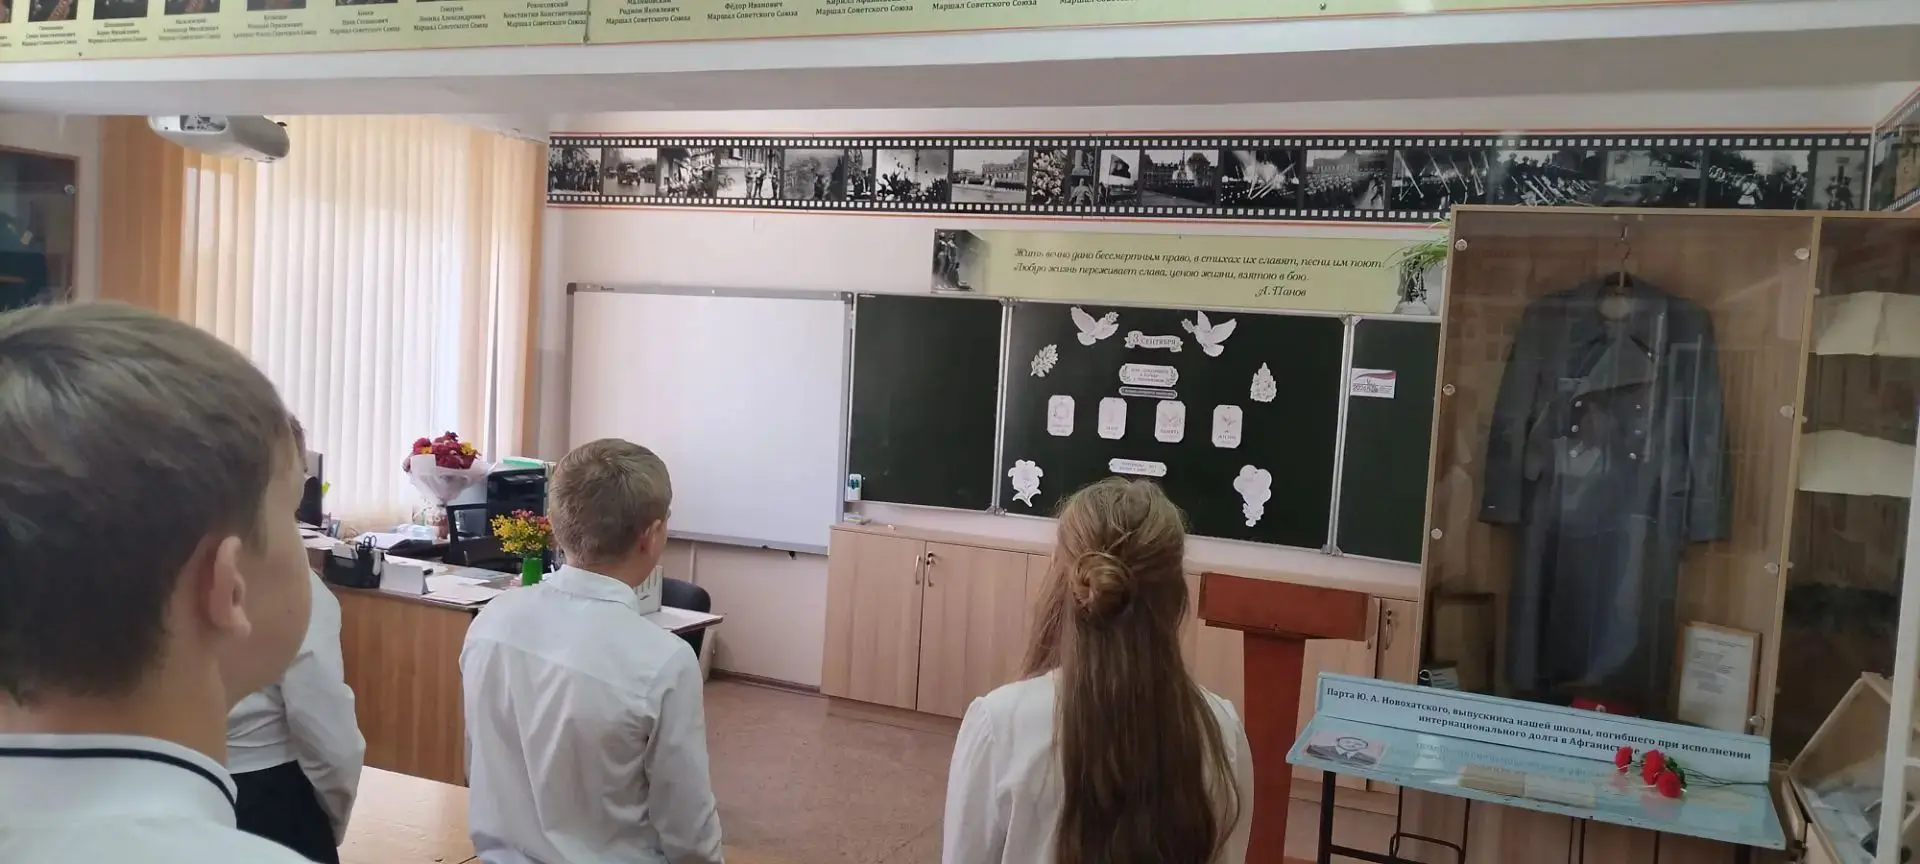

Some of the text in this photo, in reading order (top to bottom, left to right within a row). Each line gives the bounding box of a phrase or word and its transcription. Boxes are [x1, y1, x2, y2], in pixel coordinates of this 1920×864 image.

[707, 12, 735, 20] Маршал
[736, 11, 775, 19] Советского
[816, 7, 846, 16] Маршал
[848, 6, 888, 14] Советского
[606, 17, 632, 25] Маршал
[1095, 250, 1160, 262] бессмертным
[1162, 254, 1192, 264] право,
[1201, 256, 1242, 264] стихах
[1243, 256, 1257, 264] их
[1258, 257, 1299, 266] славят,
[1300, 258, 1330, 266] песни
[1079, 266, 1137, 276] переживает
[1138, 268, 1167, 277] слава,
[1169, 269, 1199, 278] ценою
[1200, 270, 1236, 280] жизни,
[1238, 272, 1278, 280] взятою
[1279, 272, 1284, 280] в
[1272, 285, 1306, 296] Панов
[1326, 687, 1752, 760] Парта Ю. А. Новохатского, выпускника нашей школы, погибшего при исполнении
[1418, 715, 1526, 738] интернационального
[1528, 732, 1558, 743] долга
[1570, 738, 1640, 756] Афганисте
